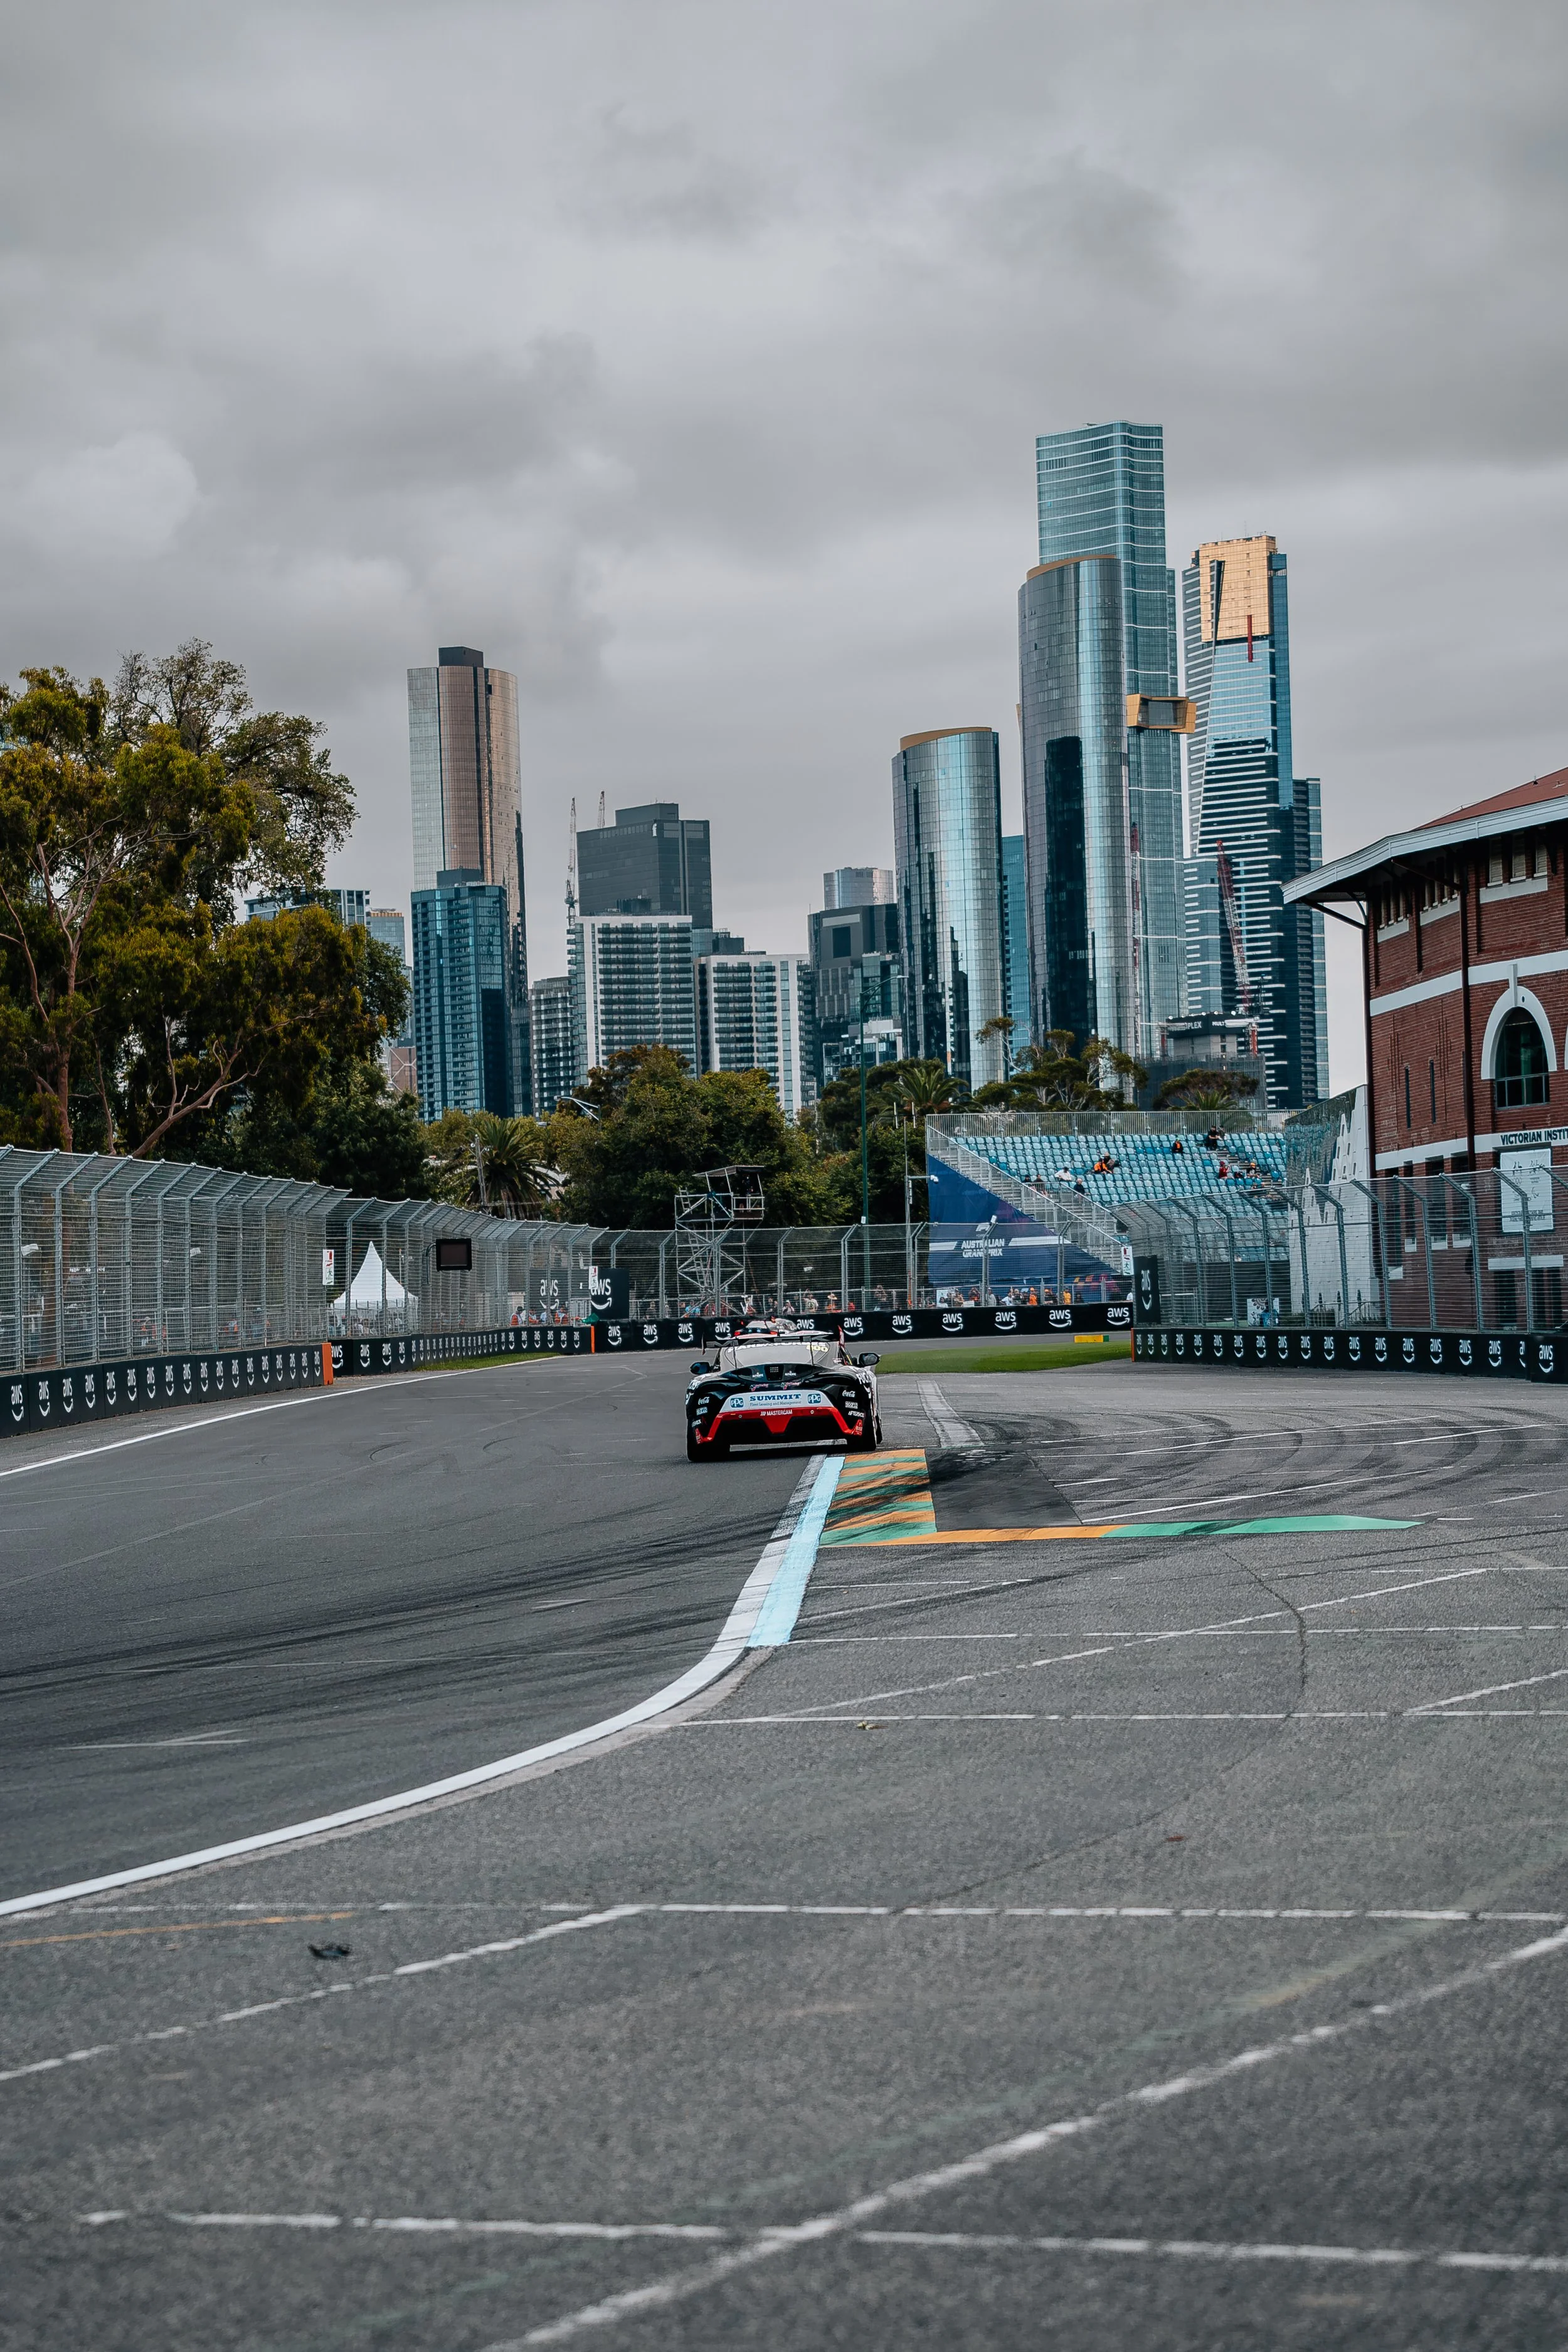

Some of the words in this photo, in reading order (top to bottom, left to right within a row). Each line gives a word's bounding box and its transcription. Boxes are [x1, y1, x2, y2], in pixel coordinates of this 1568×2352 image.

[1500, 1131, 1542, 1145] VICTORIAN
[943, 1313, 962, 1323] aws
[995, 1312, 1015, 1322] aws
[1049, 1310, 1071, 1320] aws
[1108, 1308, 1129, 1318] aws
[797, 1319, 814, 1330] aws
[844, 1317, 862, 1327] aws
[893, 1315, 911, 1325] aws
[608, 1326, 620, 1337] aws
[644, 1325, 657, 1335] aws
[679, 1323, 692, 1333] aws
[715, 1322, 730, 1333] aws
[1234, 1335, 1242, 1347] aws
[1256, 1336, 1265, 1347] aws
[1278, 1336, 1287, 1348] aws
[1301, 1336, 1310, 1348] aws
[1324, 1337, 1333, 1349] aws
[1349, 1337, 1359, 1349] aws
[1375, 1338, 1385, 1350] aws
[1403, 1338, 1414, 1352] aws
[1431, 1338, 1441, 1352] aws
[1459, 1340, 1471, 1353] aws
[1489, 1340, 1500, 1354] aws
[361, 1345, 369, 1357] aws
[383, 1343, 391, 1355] aws
[1539, 1345, 1553, 1360] aws
[85, 1374, 94, 1392] aws
[107, 1372, 115, 1390] aws
[127, 1369, 135, 1386] aws
[39, 1381, 49, 1400] aws
[63, 1378, 72, 1397] aws
[11, 1385, 23, 1405] aws
[808, 1394, 821, 1404] PPG
[731, 1398, 743, 1407] PPG
